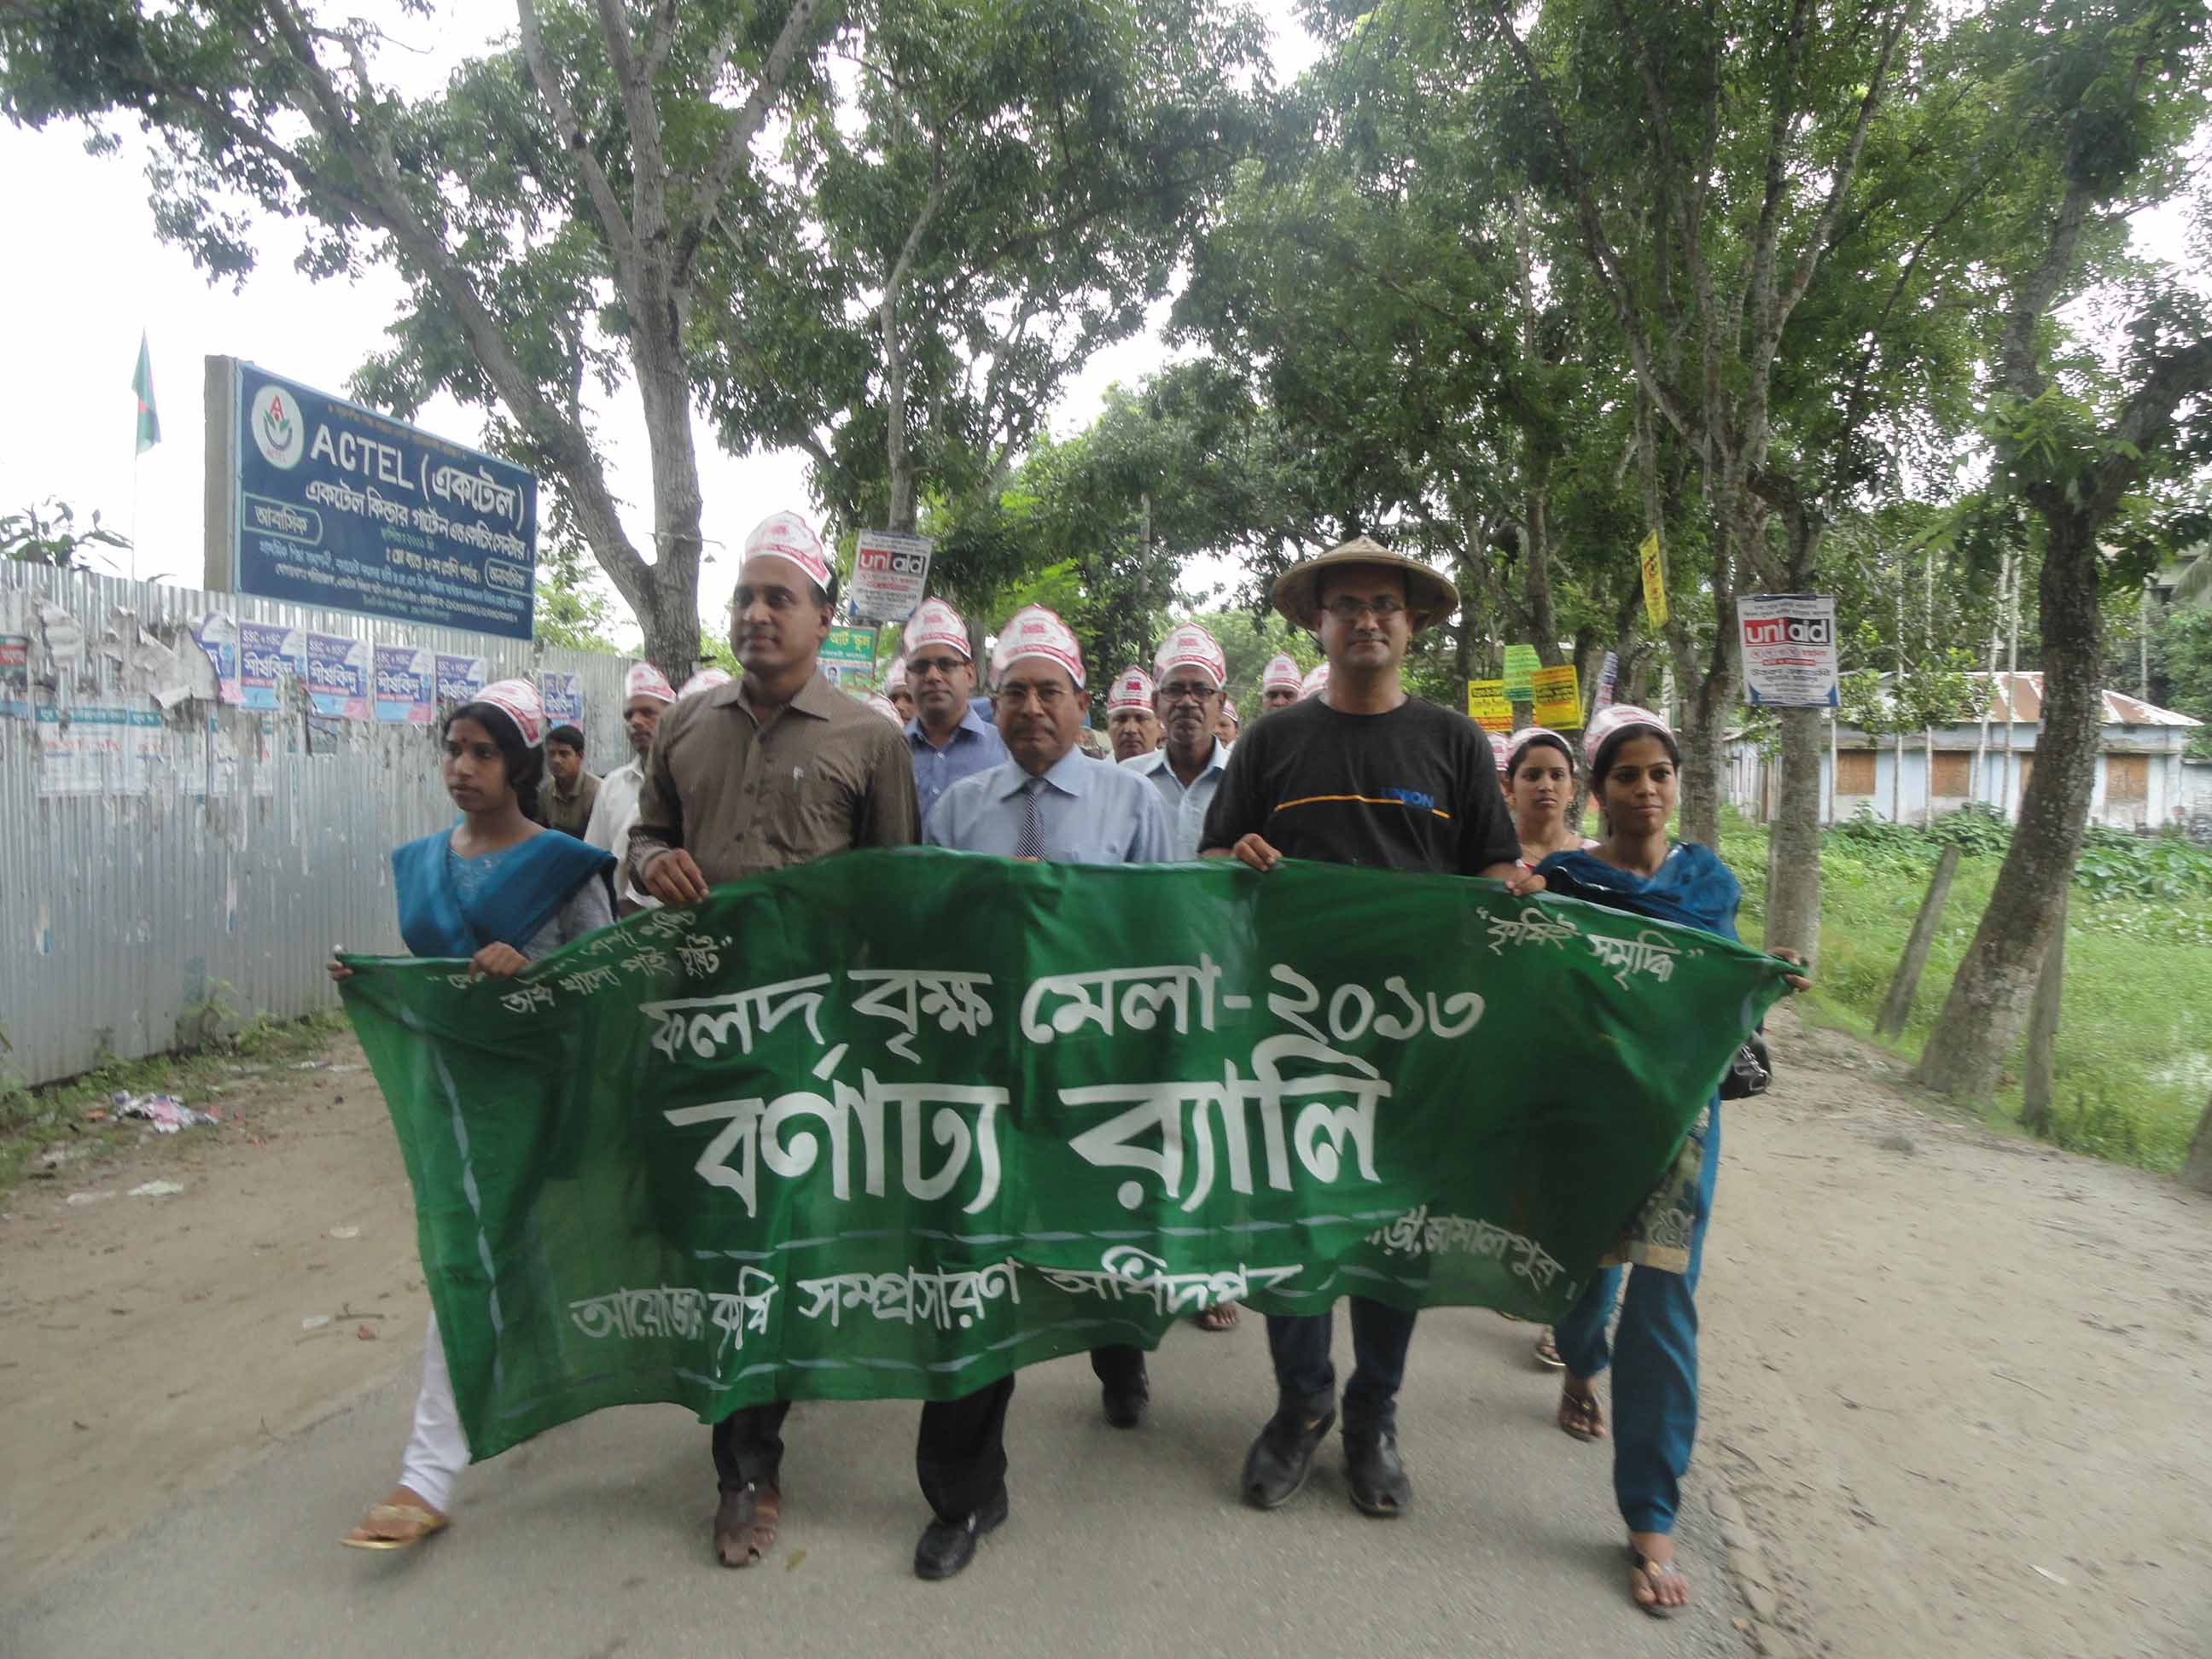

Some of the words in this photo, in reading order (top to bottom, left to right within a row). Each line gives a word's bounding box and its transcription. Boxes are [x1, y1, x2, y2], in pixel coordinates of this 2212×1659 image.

[310, 423, 415, 490] ACTEL
[306, 478, 365, 515] একটেল
[1746, 619, 1828, 643] uniaid
[640, 973, 833, 1063] ফলদ
[848, 969, 995, 1065] বৃক্ষ
[663, 1043, 1010, 1219] বর্ণাঢ্য
